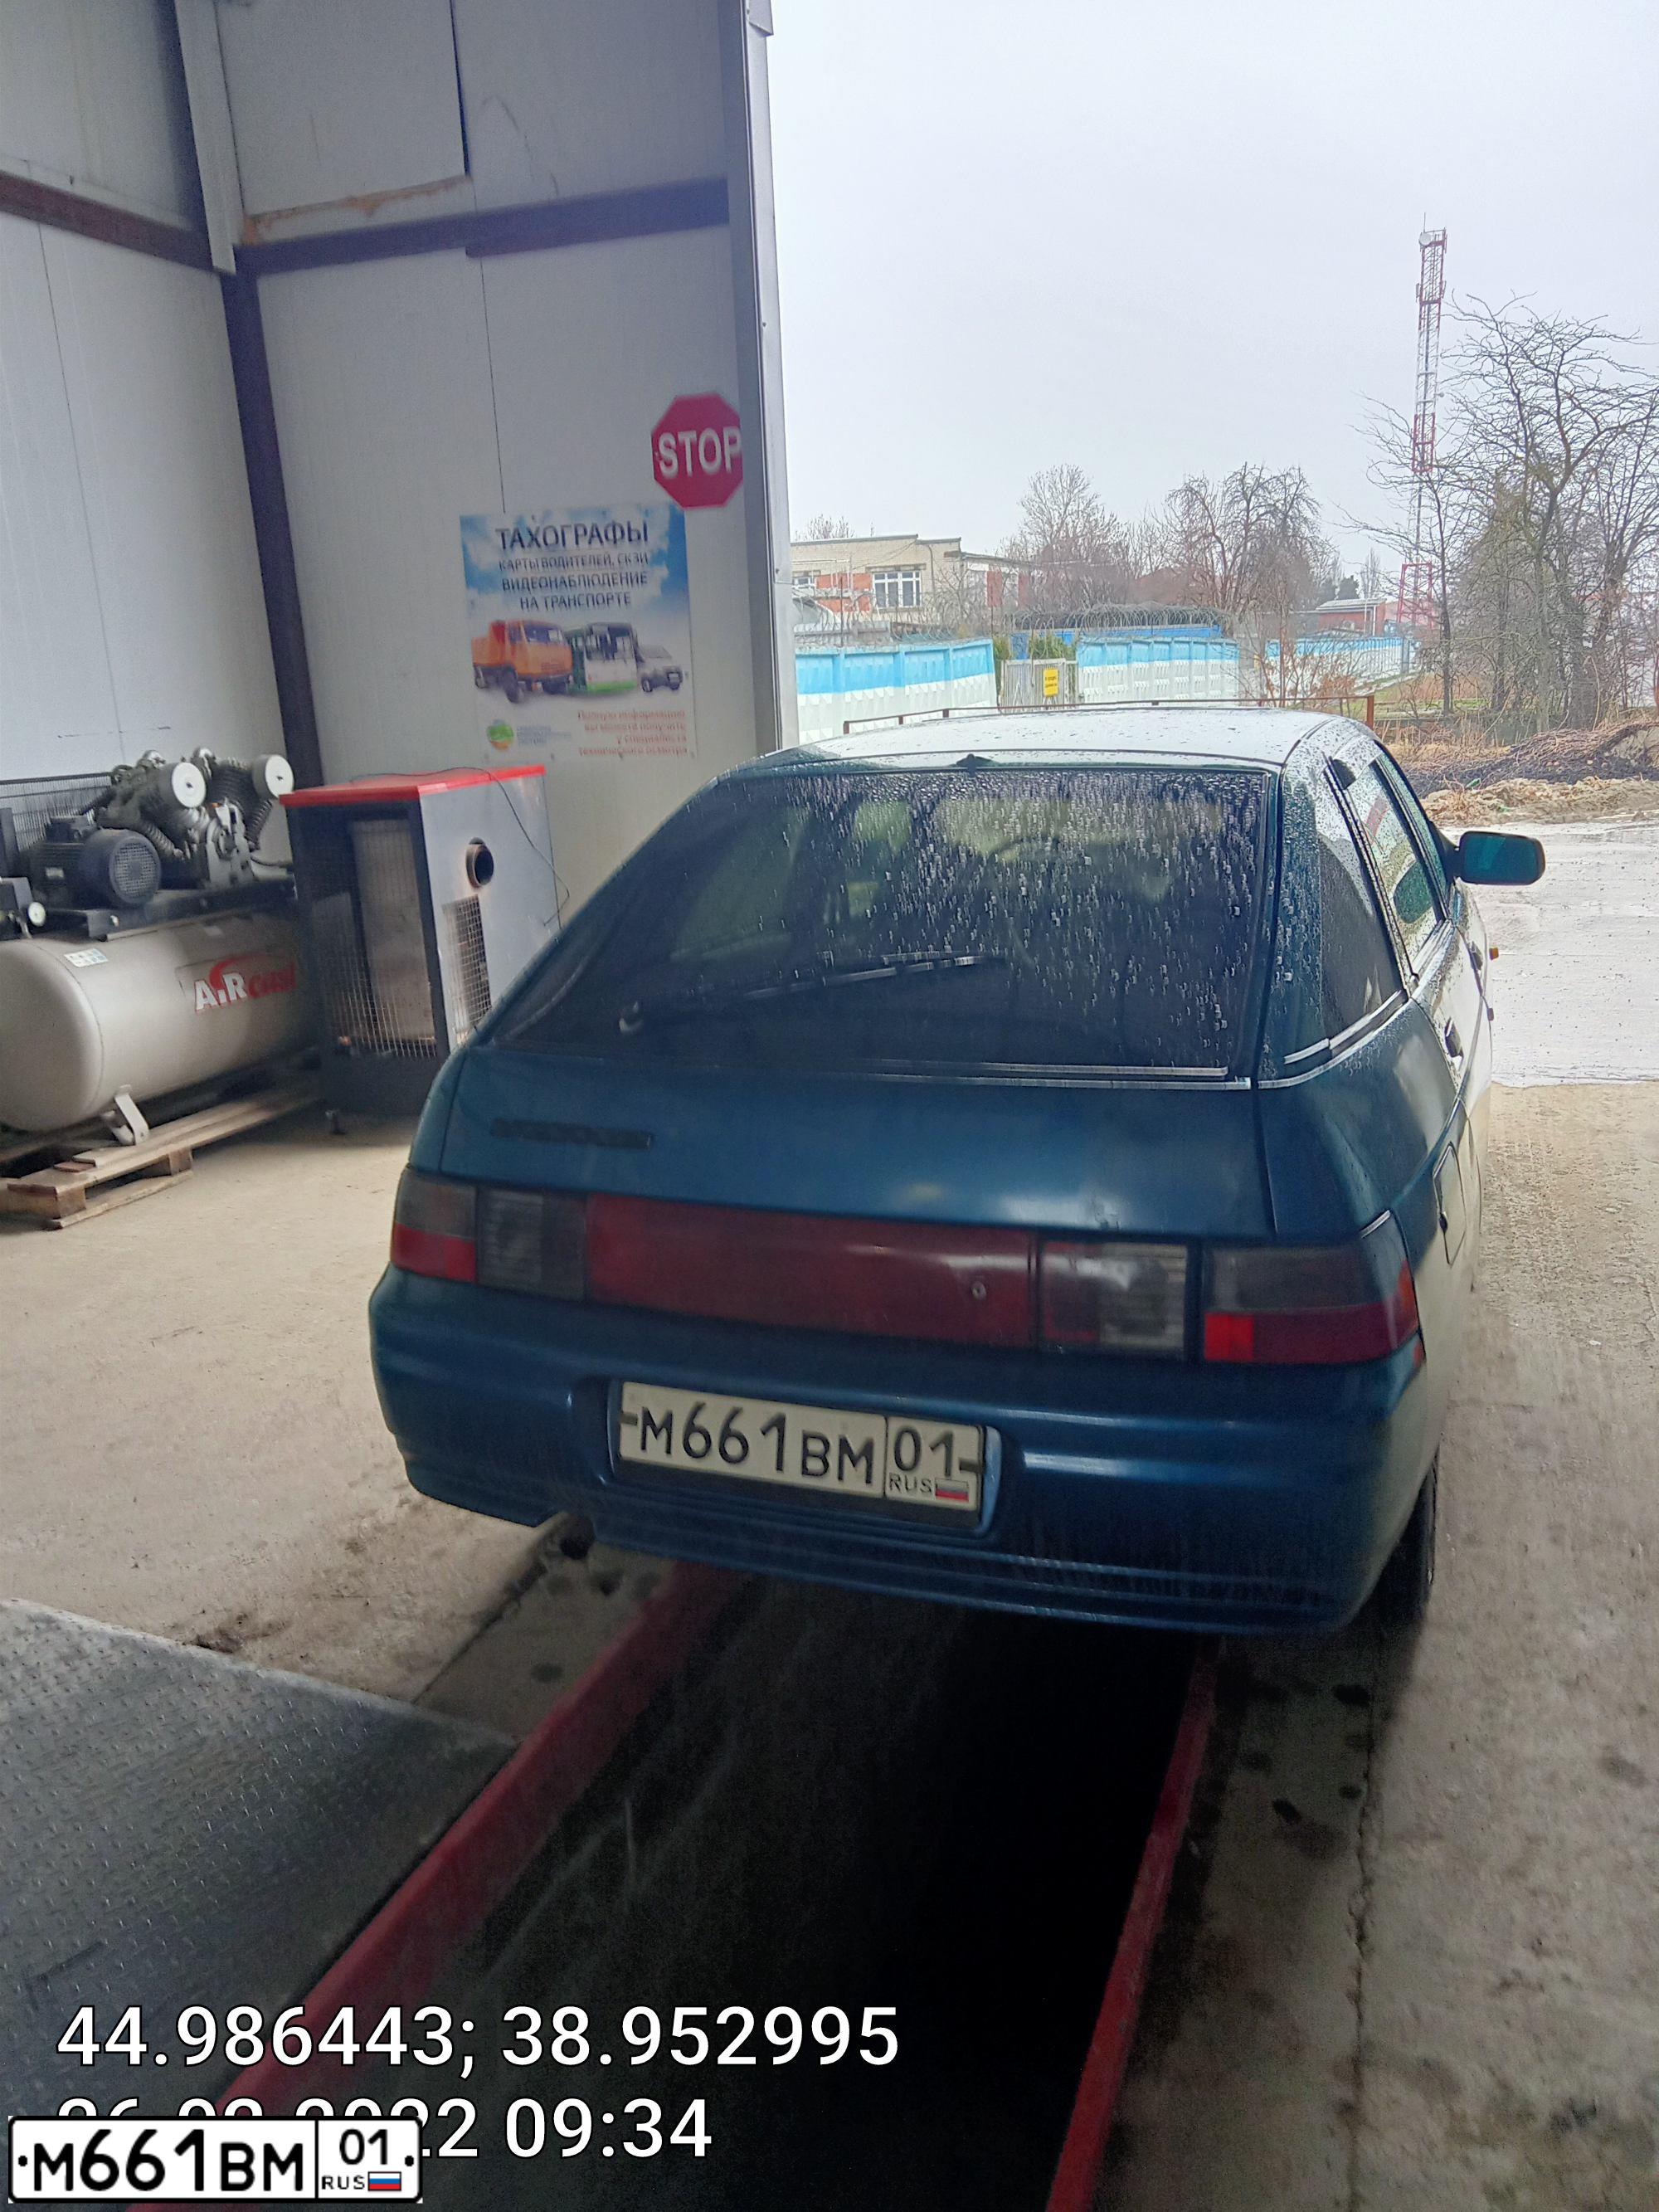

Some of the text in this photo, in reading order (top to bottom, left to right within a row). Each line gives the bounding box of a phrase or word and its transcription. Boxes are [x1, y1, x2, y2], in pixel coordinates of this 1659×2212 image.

[659, 426, 742, 479] STOP
[495, 520, 649, 549] ТАХОГРАФЫ
[499, 558, 539, 572] КАРТЫ
[502, 571, 648, 592] ВИДЕОНАБЛЮДЕНИЕ
[520, 592, 631, 611] НА ТРАНСПОРТЕ
[893, 1425, 955, 1478] 01
[888, 1473, 932, 1494] RUS
